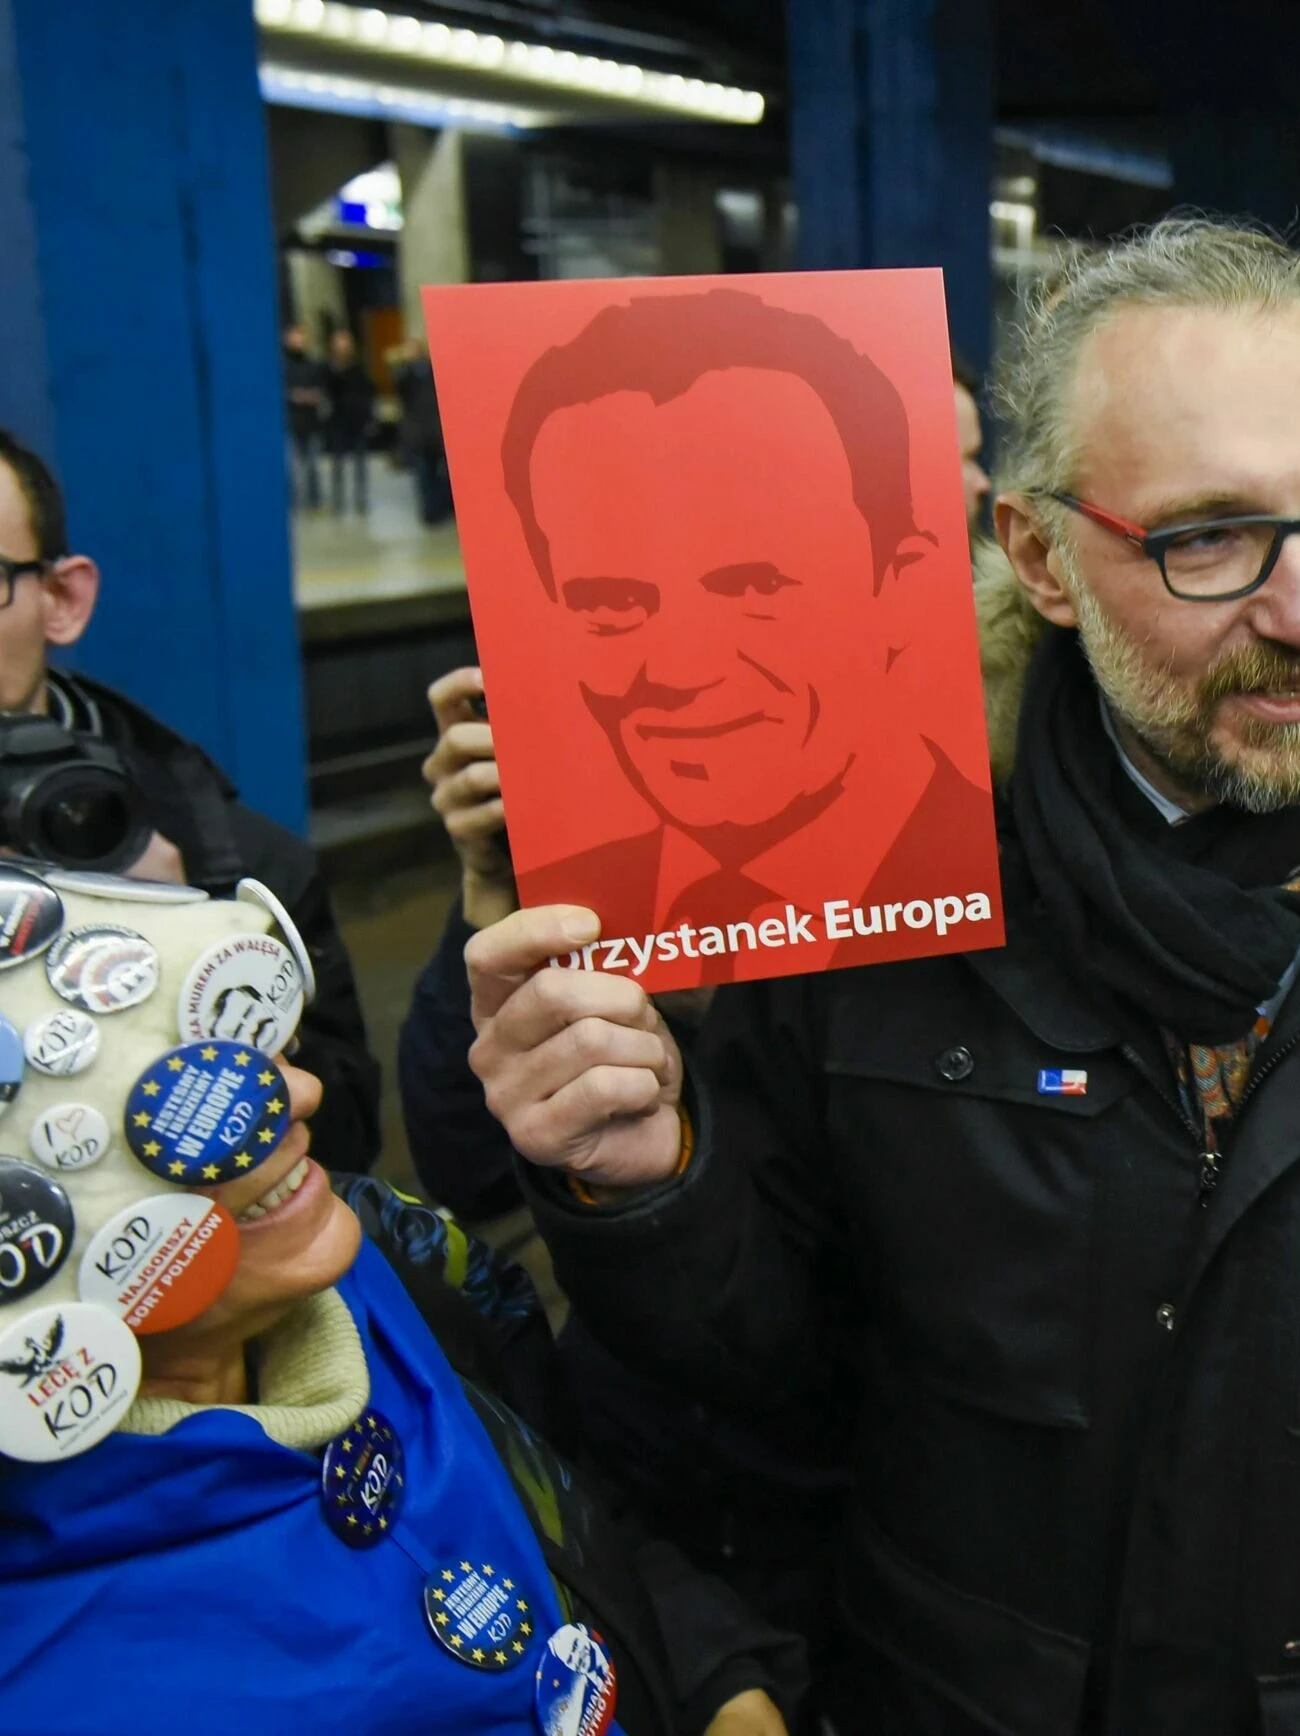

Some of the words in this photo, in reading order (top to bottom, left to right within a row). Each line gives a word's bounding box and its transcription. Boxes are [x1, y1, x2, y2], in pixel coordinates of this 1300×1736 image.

[824, 892, 992, 939] Europa
[266, 959, 294, 1005] KOD
[187, 1067, 246, 1140] EUROPIE
[219, 1101, 253, 1147] KOD
[55, 1138, 99, 1167] KOD
[174, 1134, 206, 1158] W
[95, 1216, 150, 1279] KOD
[118, 1217, 193, 1305] NAJGORSZY
[126, 1285, 164, 1328] SORT
[77, 1347, 96, 1366] Z
[44, 1362, 117, 1440] KOD
[360, 1453, 388, 1512] KOD
[456, 1617, 478, 1640] W
[466, 1583, 509, 1630] EUROPIE
[487, 1613, 512, 1643] KOD
